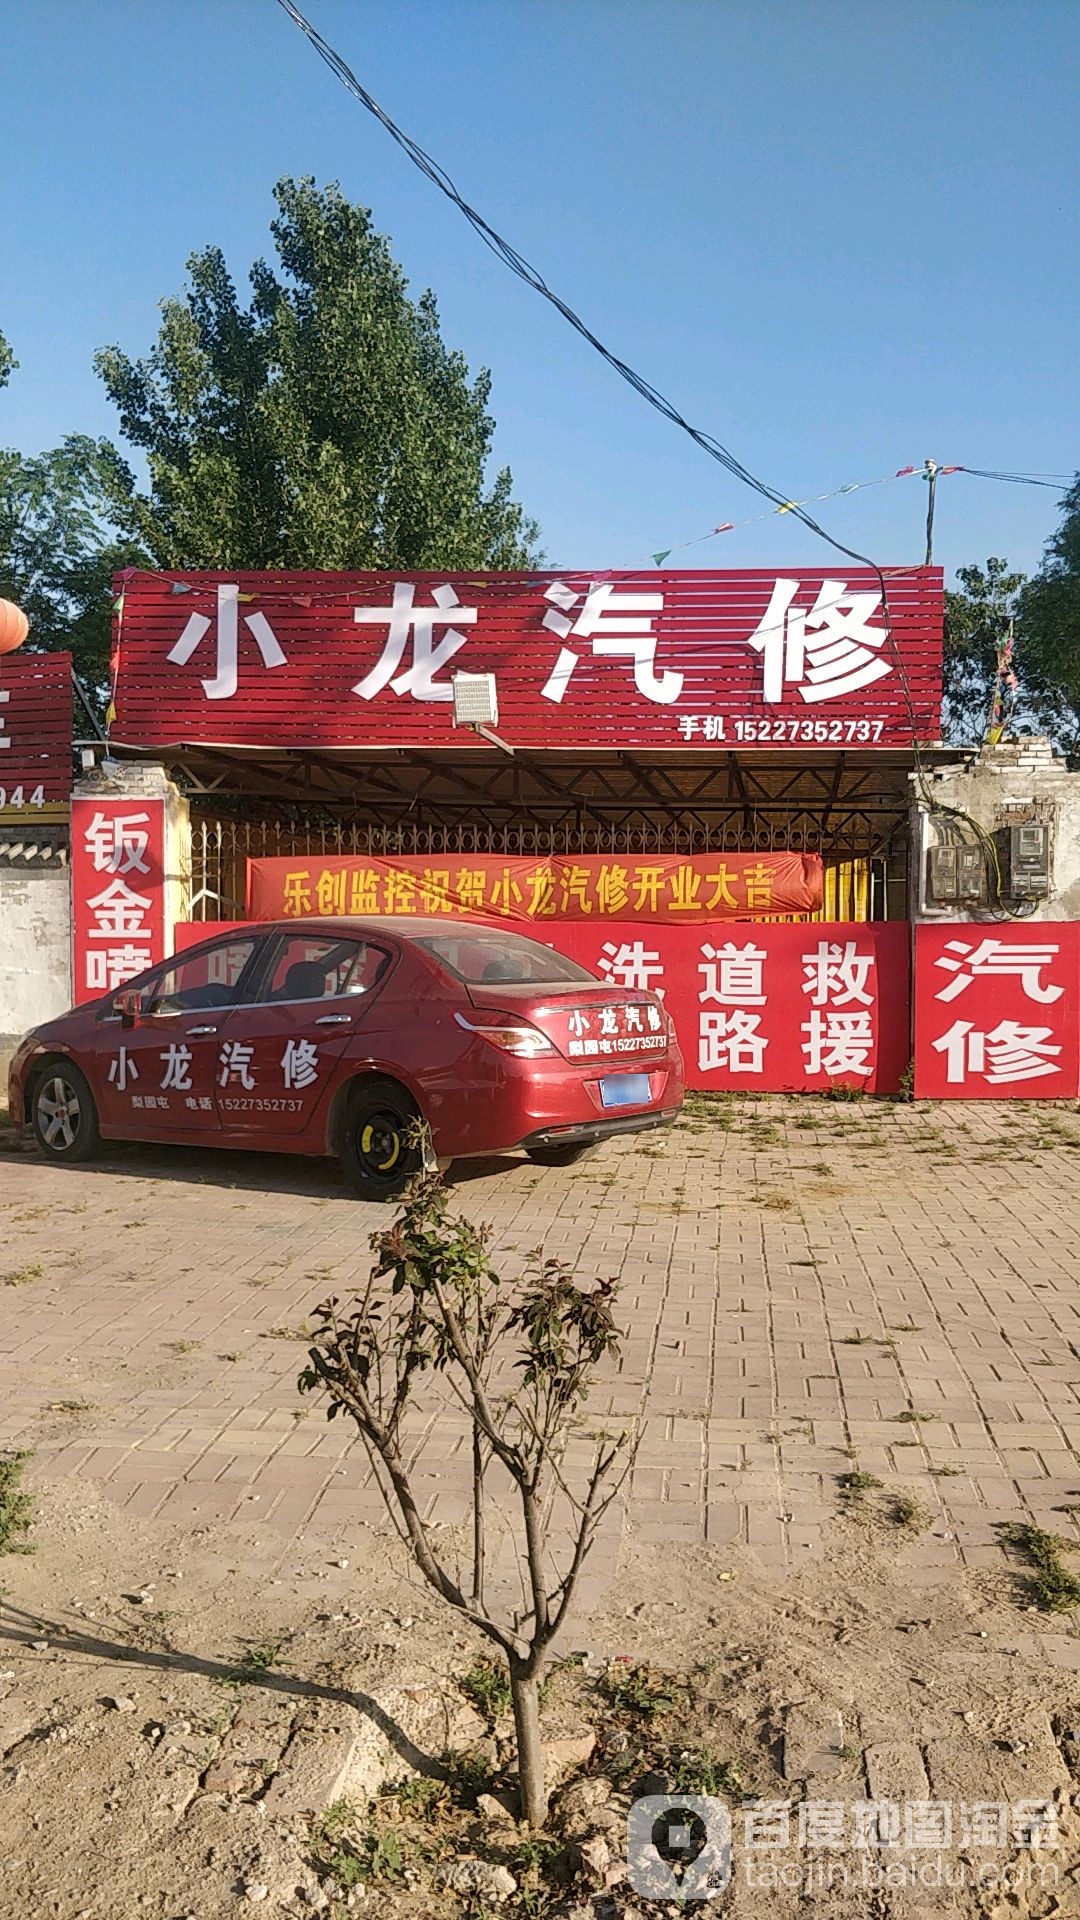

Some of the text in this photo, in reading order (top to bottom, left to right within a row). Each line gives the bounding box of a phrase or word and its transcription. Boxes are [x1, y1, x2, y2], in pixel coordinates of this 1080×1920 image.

[165, 577, 894, 704] 小龙汽修
[677, 716, 884, 741] 手机 15227352737
[282, 861, 776, 917] 乐创监控祝贺小龙汽修开业大吉
[568, 1005, 661, 1037] 小龙汽修
[931, 938, 1065, 1084] 汽修
[107, 1038, 319, 1091] 小龙汽修
[185, 1096, 213, 1111] 电话
[218, 1098, 304, 1112] 15227352737
